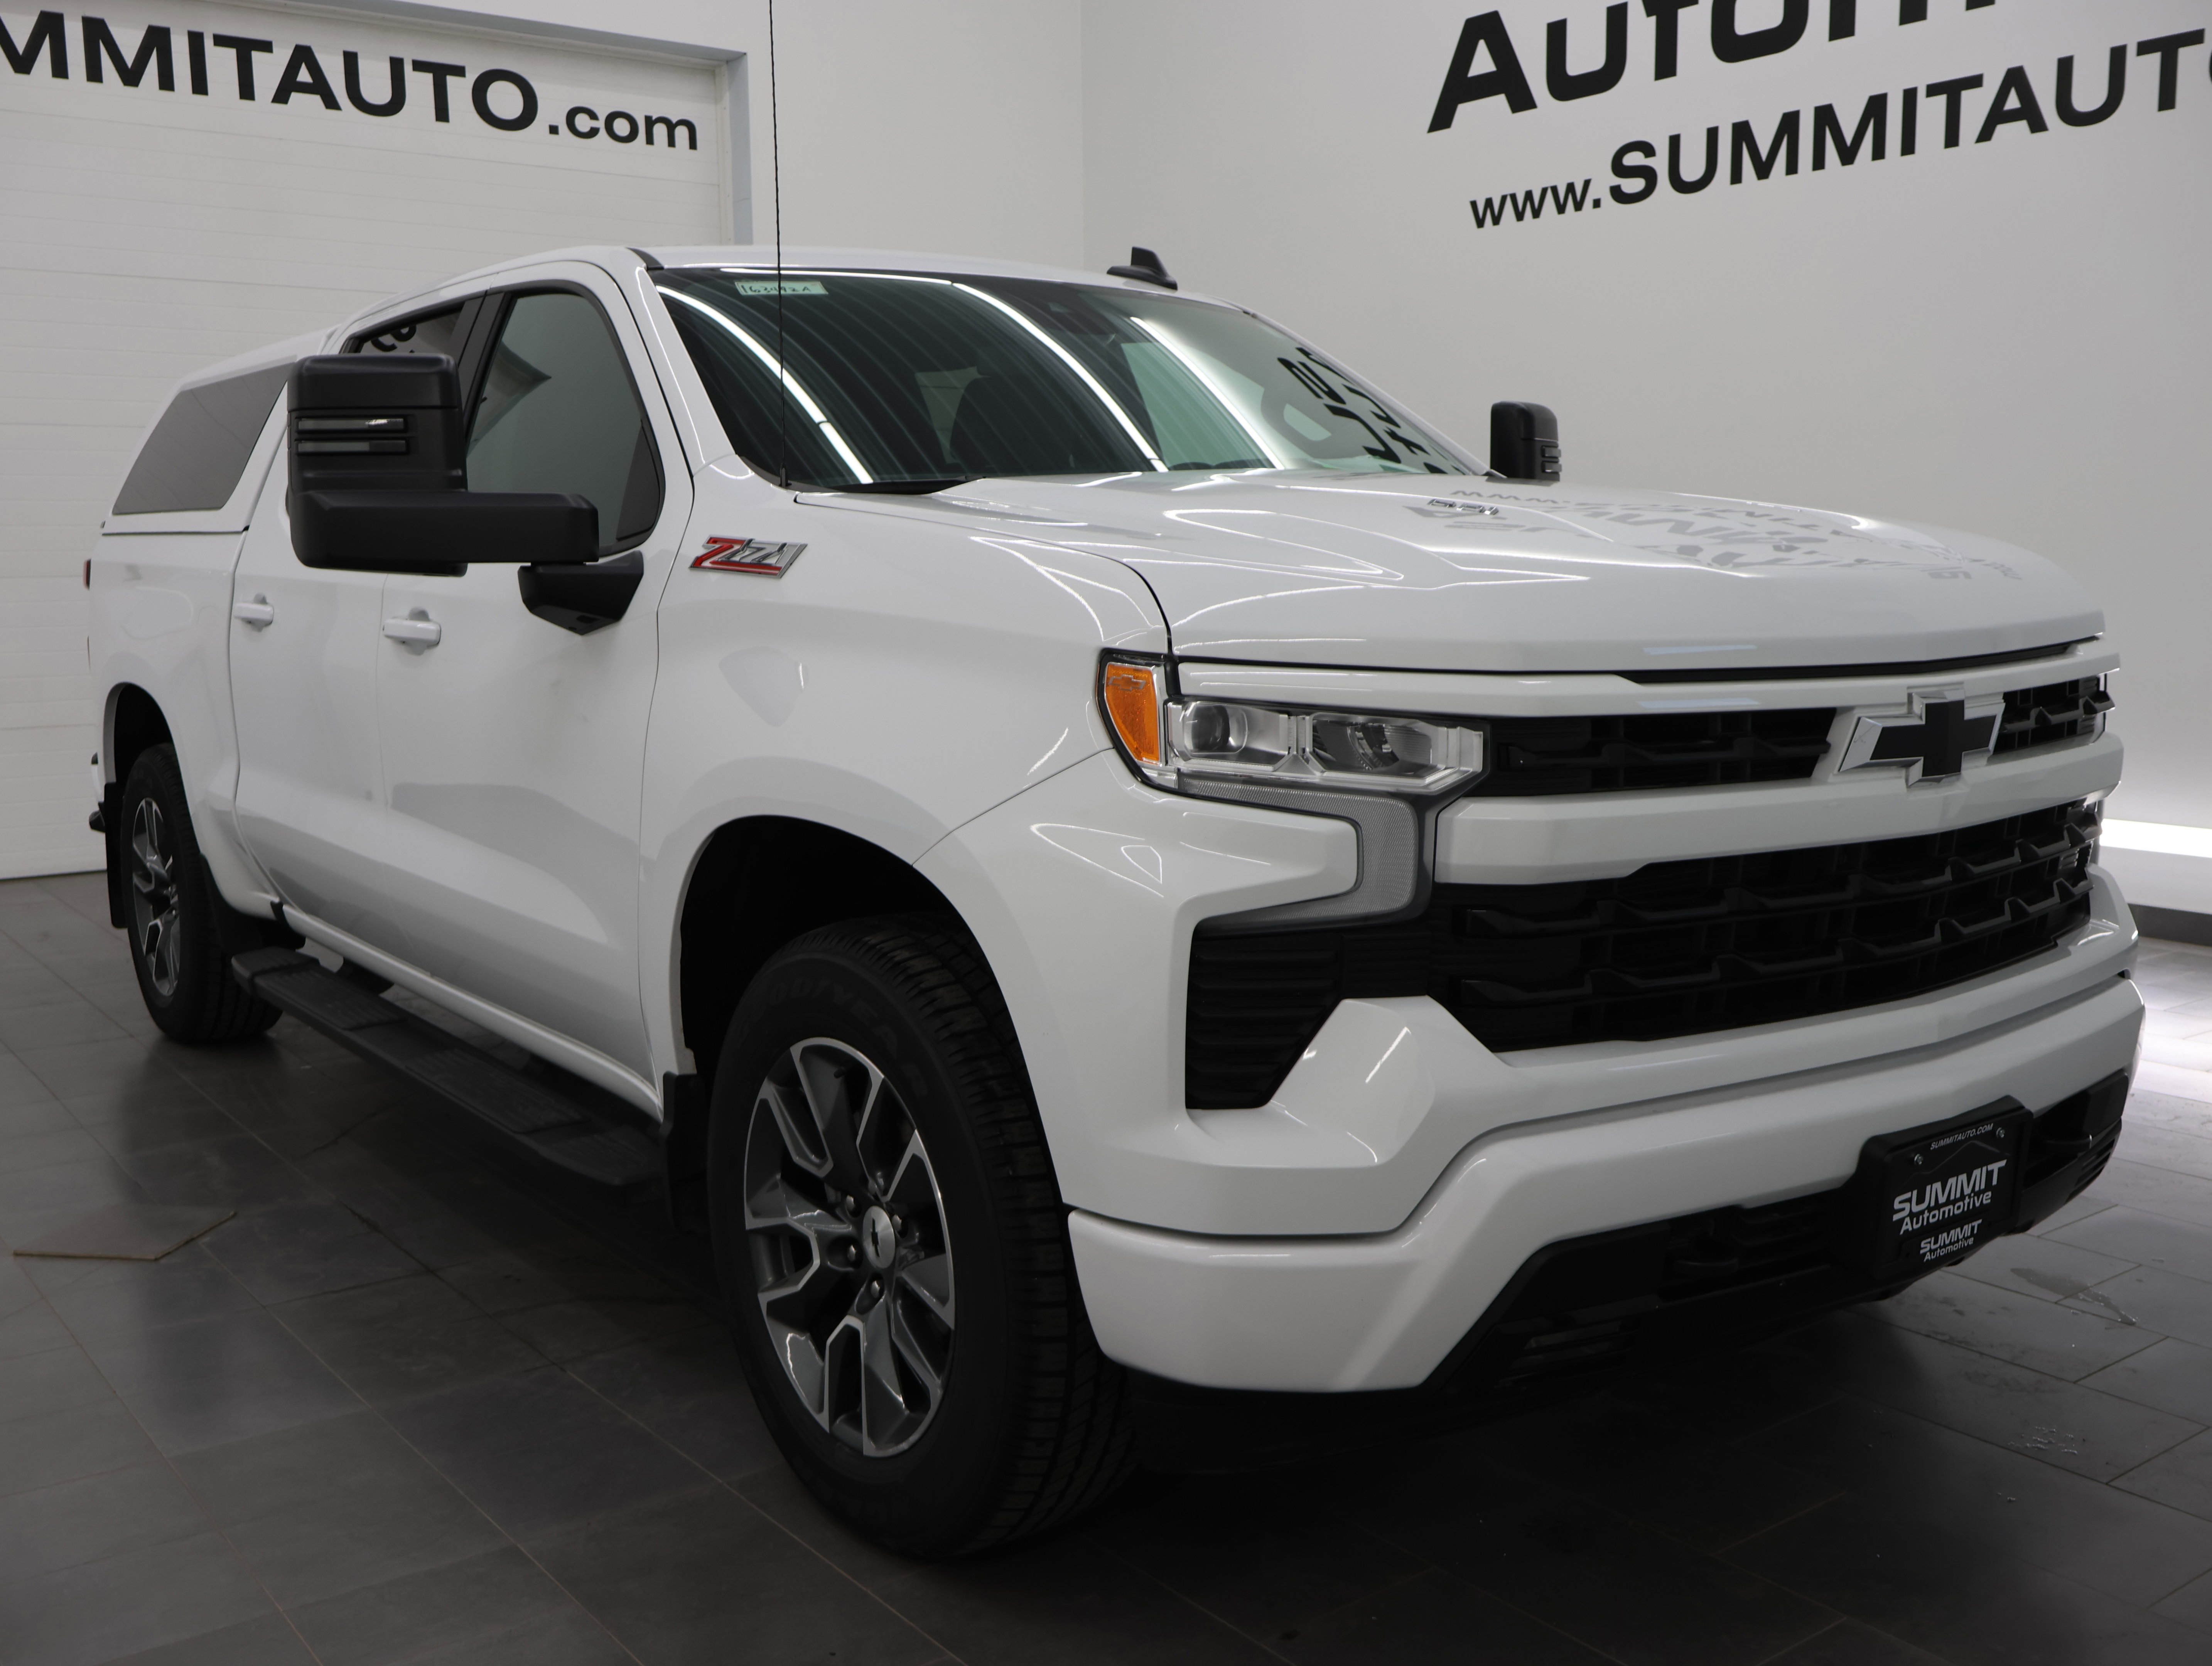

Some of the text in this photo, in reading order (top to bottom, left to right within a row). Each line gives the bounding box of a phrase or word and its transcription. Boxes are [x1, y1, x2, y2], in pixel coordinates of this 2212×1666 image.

[1470, 28, 2212, 229] www.SUMMITAUT
[1930, 1123, 1993, 1150] SUMMITAUTO.COM
[1893, 1159, 2007, 1222] SUMMIT
[1900, 1190, 1992, 1235] Automotive
[1920, 1219, 1983, 1254] SUMMIT
[1923, 1237, 1974, 1262] Automotive
